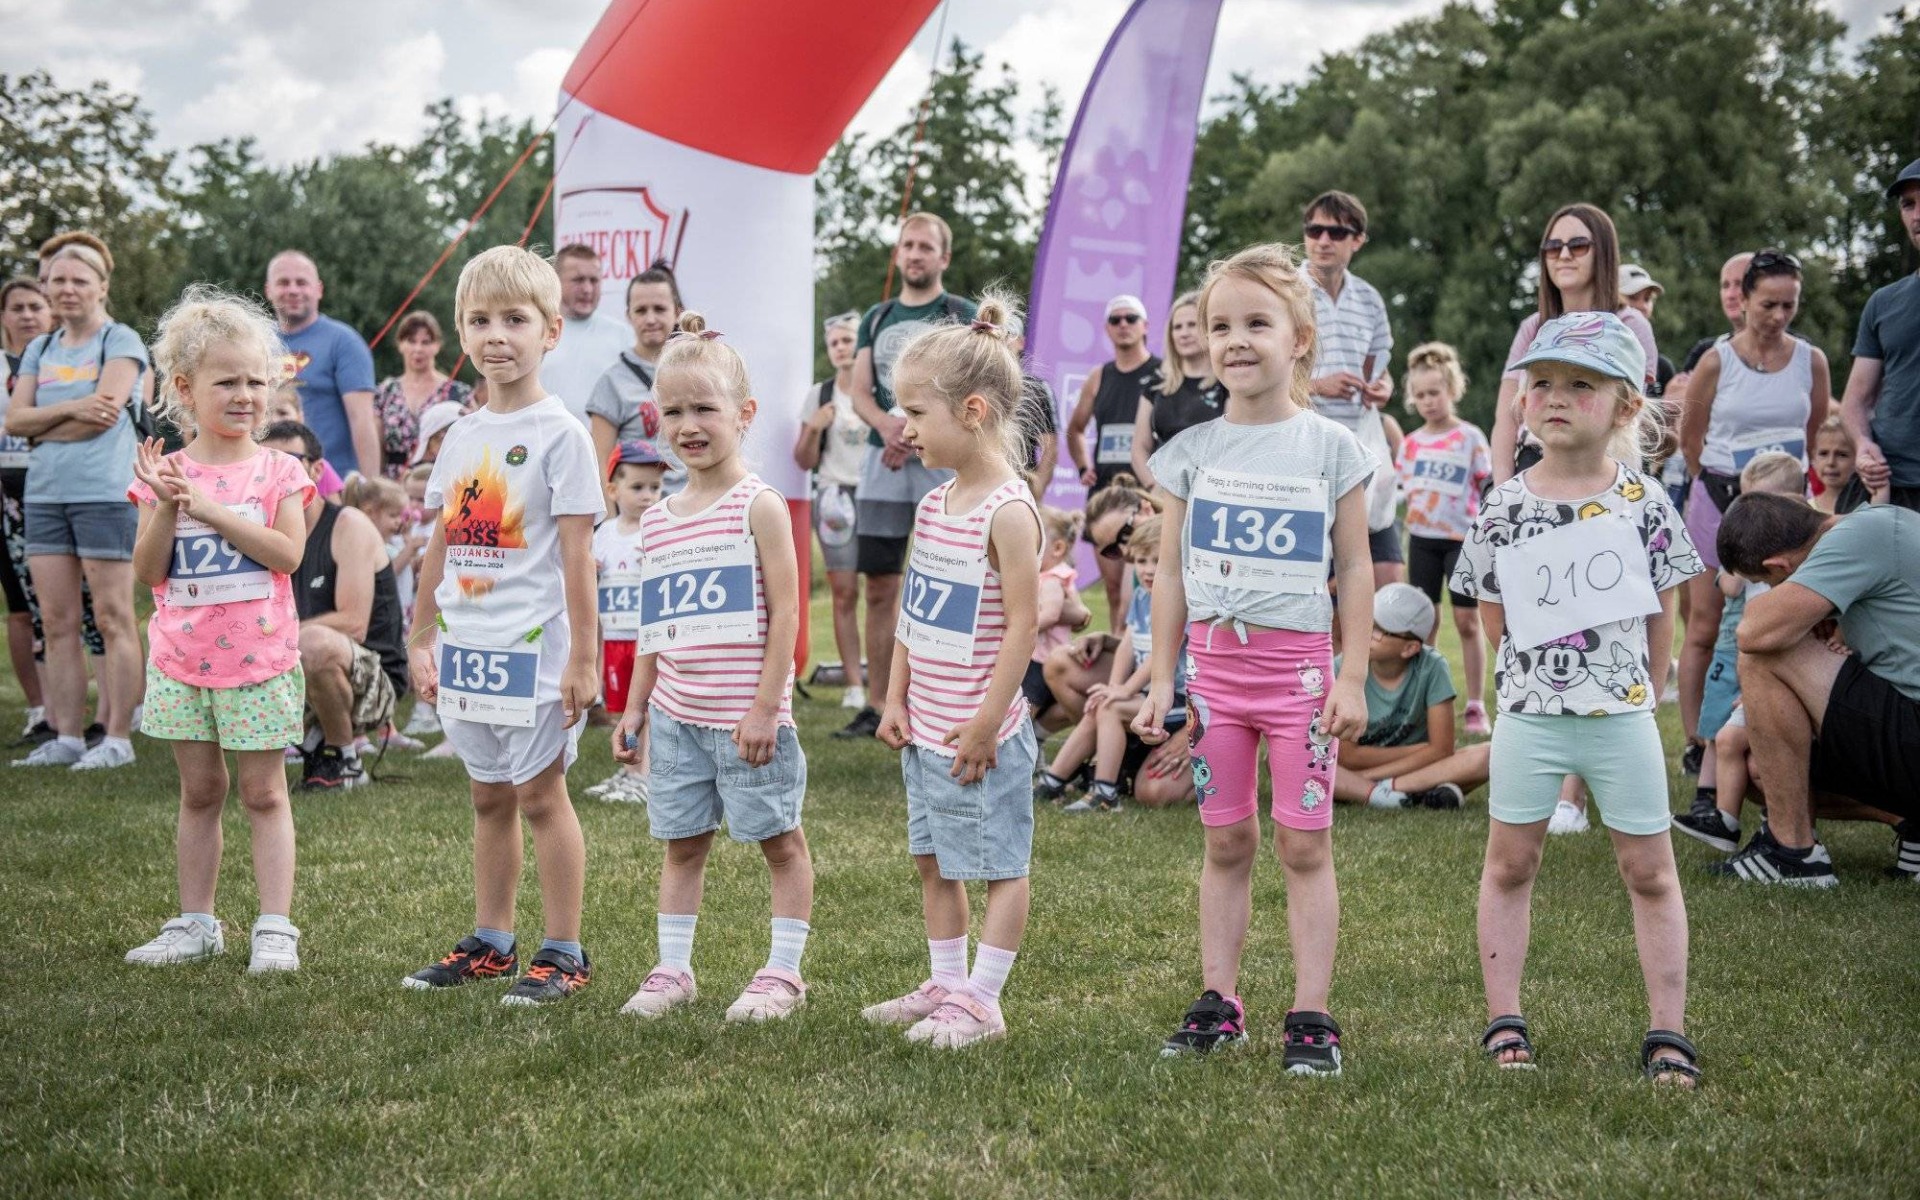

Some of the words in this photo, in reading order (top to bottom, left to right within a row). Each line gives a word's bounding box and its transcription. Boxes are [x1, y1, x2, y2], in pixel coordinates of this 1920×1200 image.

[1266, 482, 1311, 494] Oświęcim
[1422, 461, 1456, 480] 159
[469, 519, 500, 530] XXXV
[1211, 506, 1296, 555] 136
[175, 537, 244, 575] 129
[695, 544, 736, 554] Oświęcim
[658, 570, 727, 617] 126
[907, 572, 953, 621] 127
[1536, 549, 1623, 607] 210
[452, 650, 509, 692] 135
[1710, 662, 1725, 681] 3
